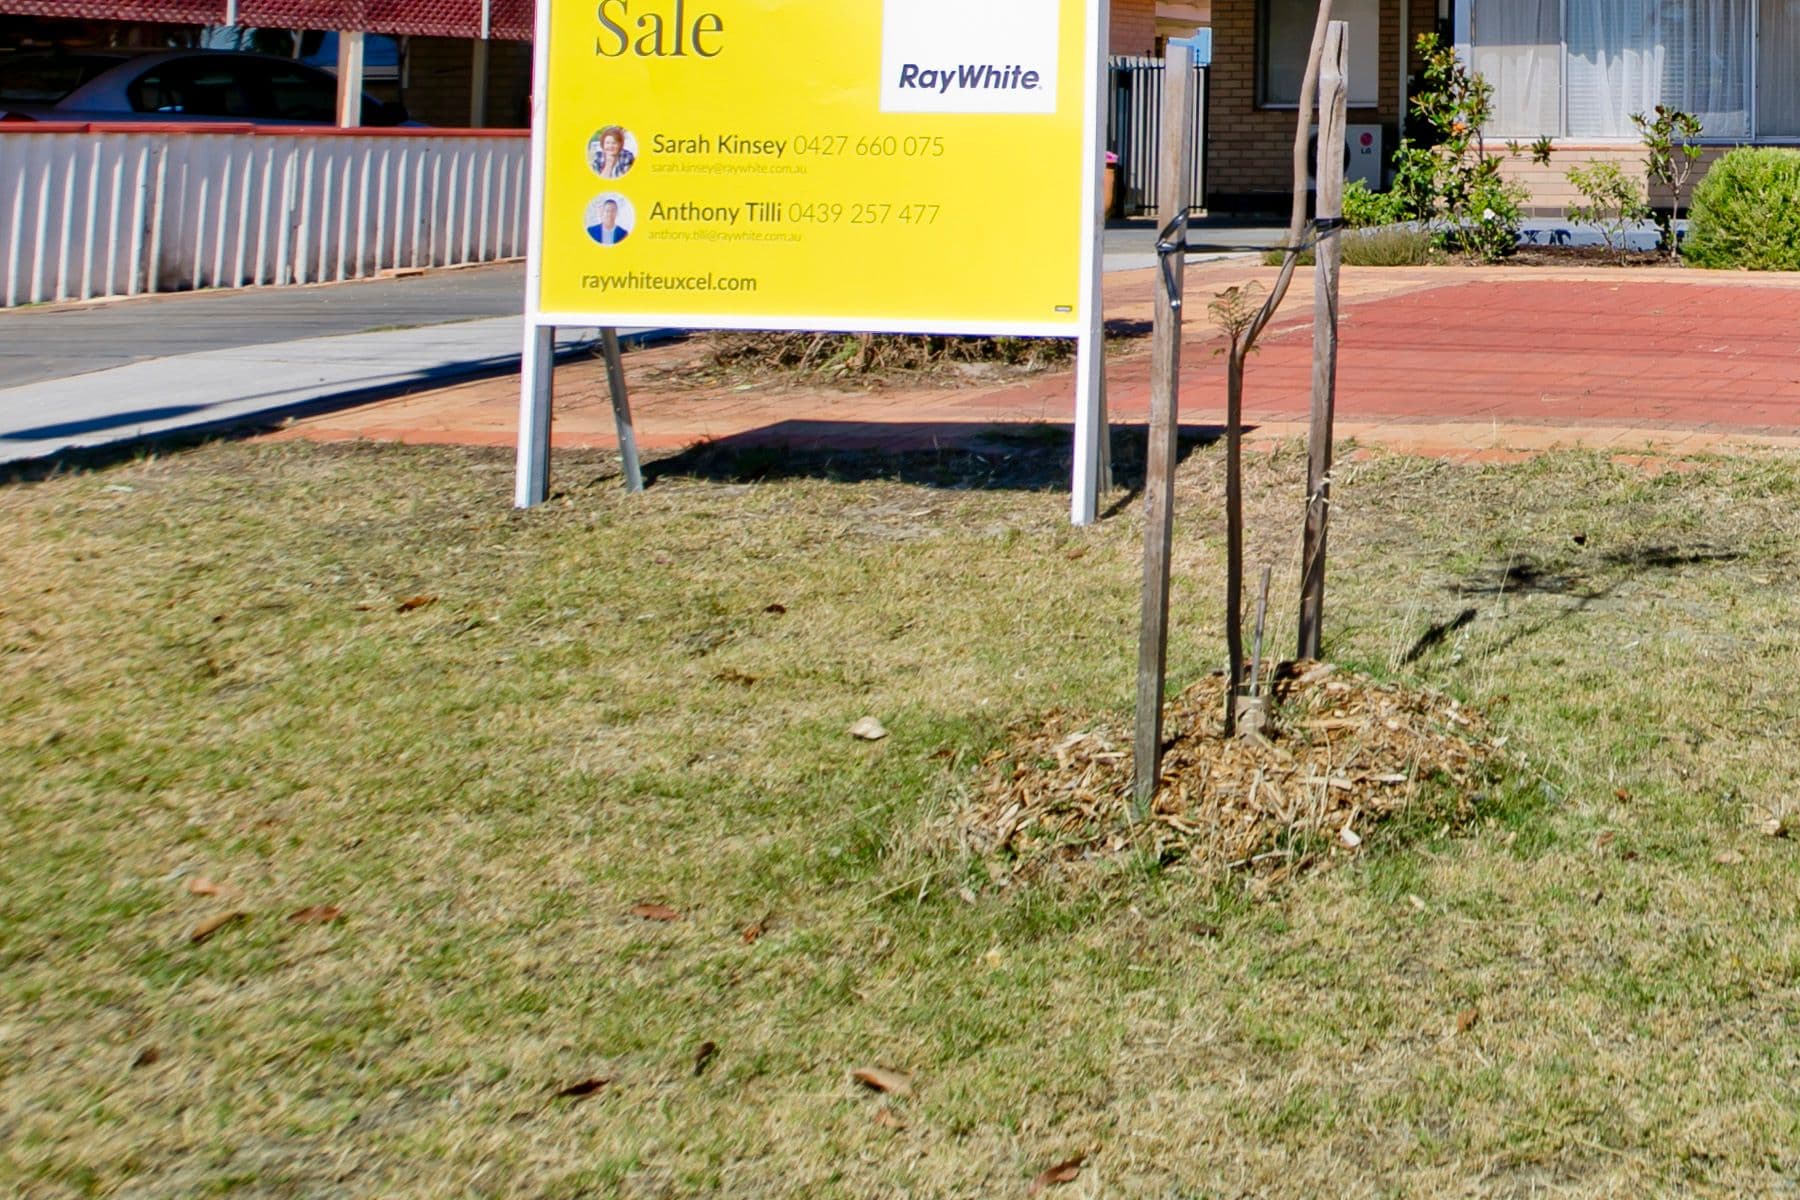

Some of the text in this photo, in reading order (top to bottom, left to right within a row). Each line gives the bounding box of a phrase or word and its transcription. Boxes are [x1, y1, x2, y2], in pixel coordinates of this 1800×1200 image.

[899, 63, 1040, 94] RayWhite
[652, 134, 945, 158] Sarah Kinsey 0427 660 075
[649, 201, 941, 225] Anthony Tilli 0439 257 477
[581, 271, 757, 293] raywhiteuxcel.com
